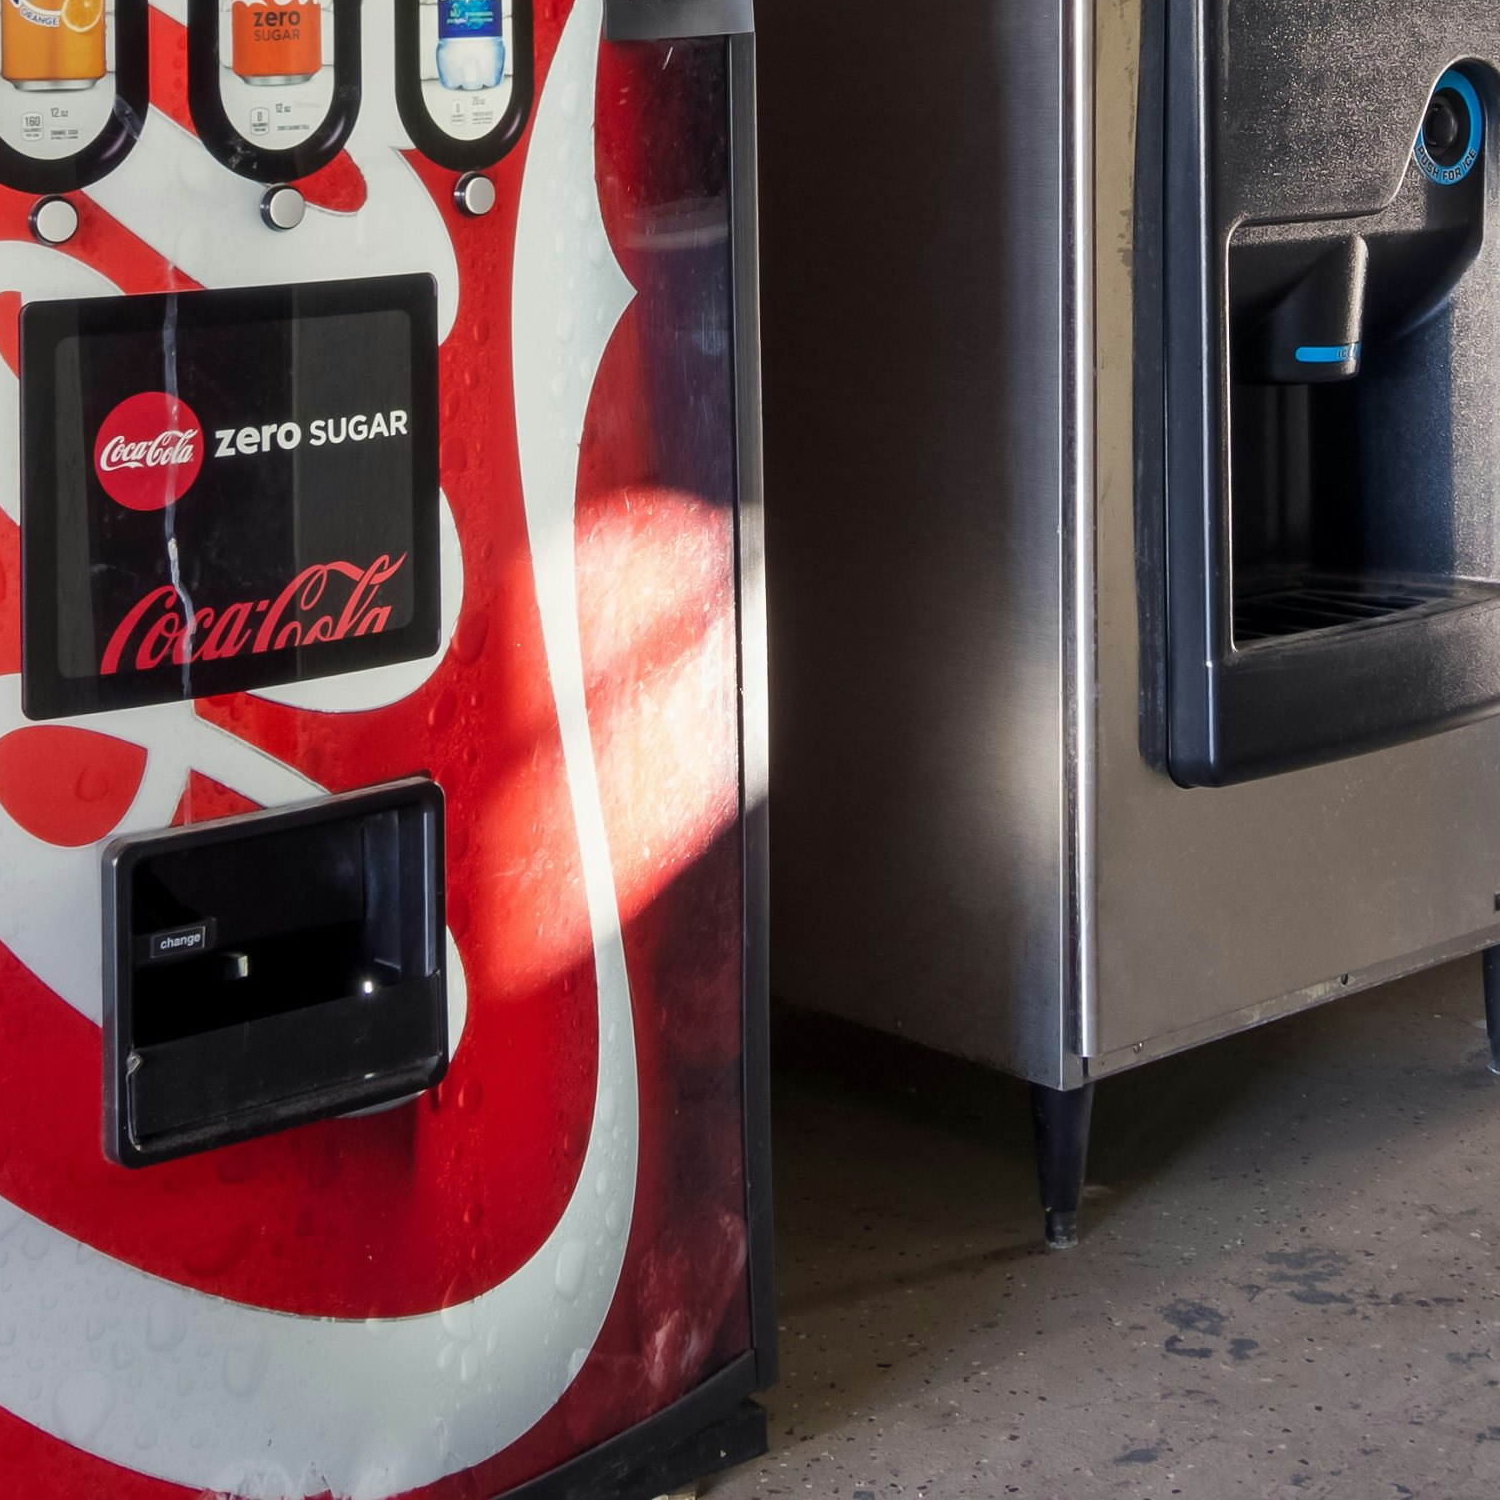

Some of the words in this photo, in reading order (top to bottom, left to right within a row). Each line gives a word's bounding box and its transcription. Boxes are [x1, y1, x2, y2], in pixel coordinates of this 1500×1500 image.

[20, 6, 59, 26] ORANGE
[253, 10, 302, 28] zero
[253, 28, 301, 43] SUGAR
[50, 107, 60, 118] 12
[24, 115, 41, 128] 160
[1417, 144, 1440, 179] PUSH
[1442, 166, 1462, 181] FOR
[1461, 147, 1477, 170] ICE
[99, 427, 199, 472] Coca-Cola
[214, 421, 302, 458] zero
[308, 409, 408, 446] SUGAR
[160, 933, 202, 950] change
